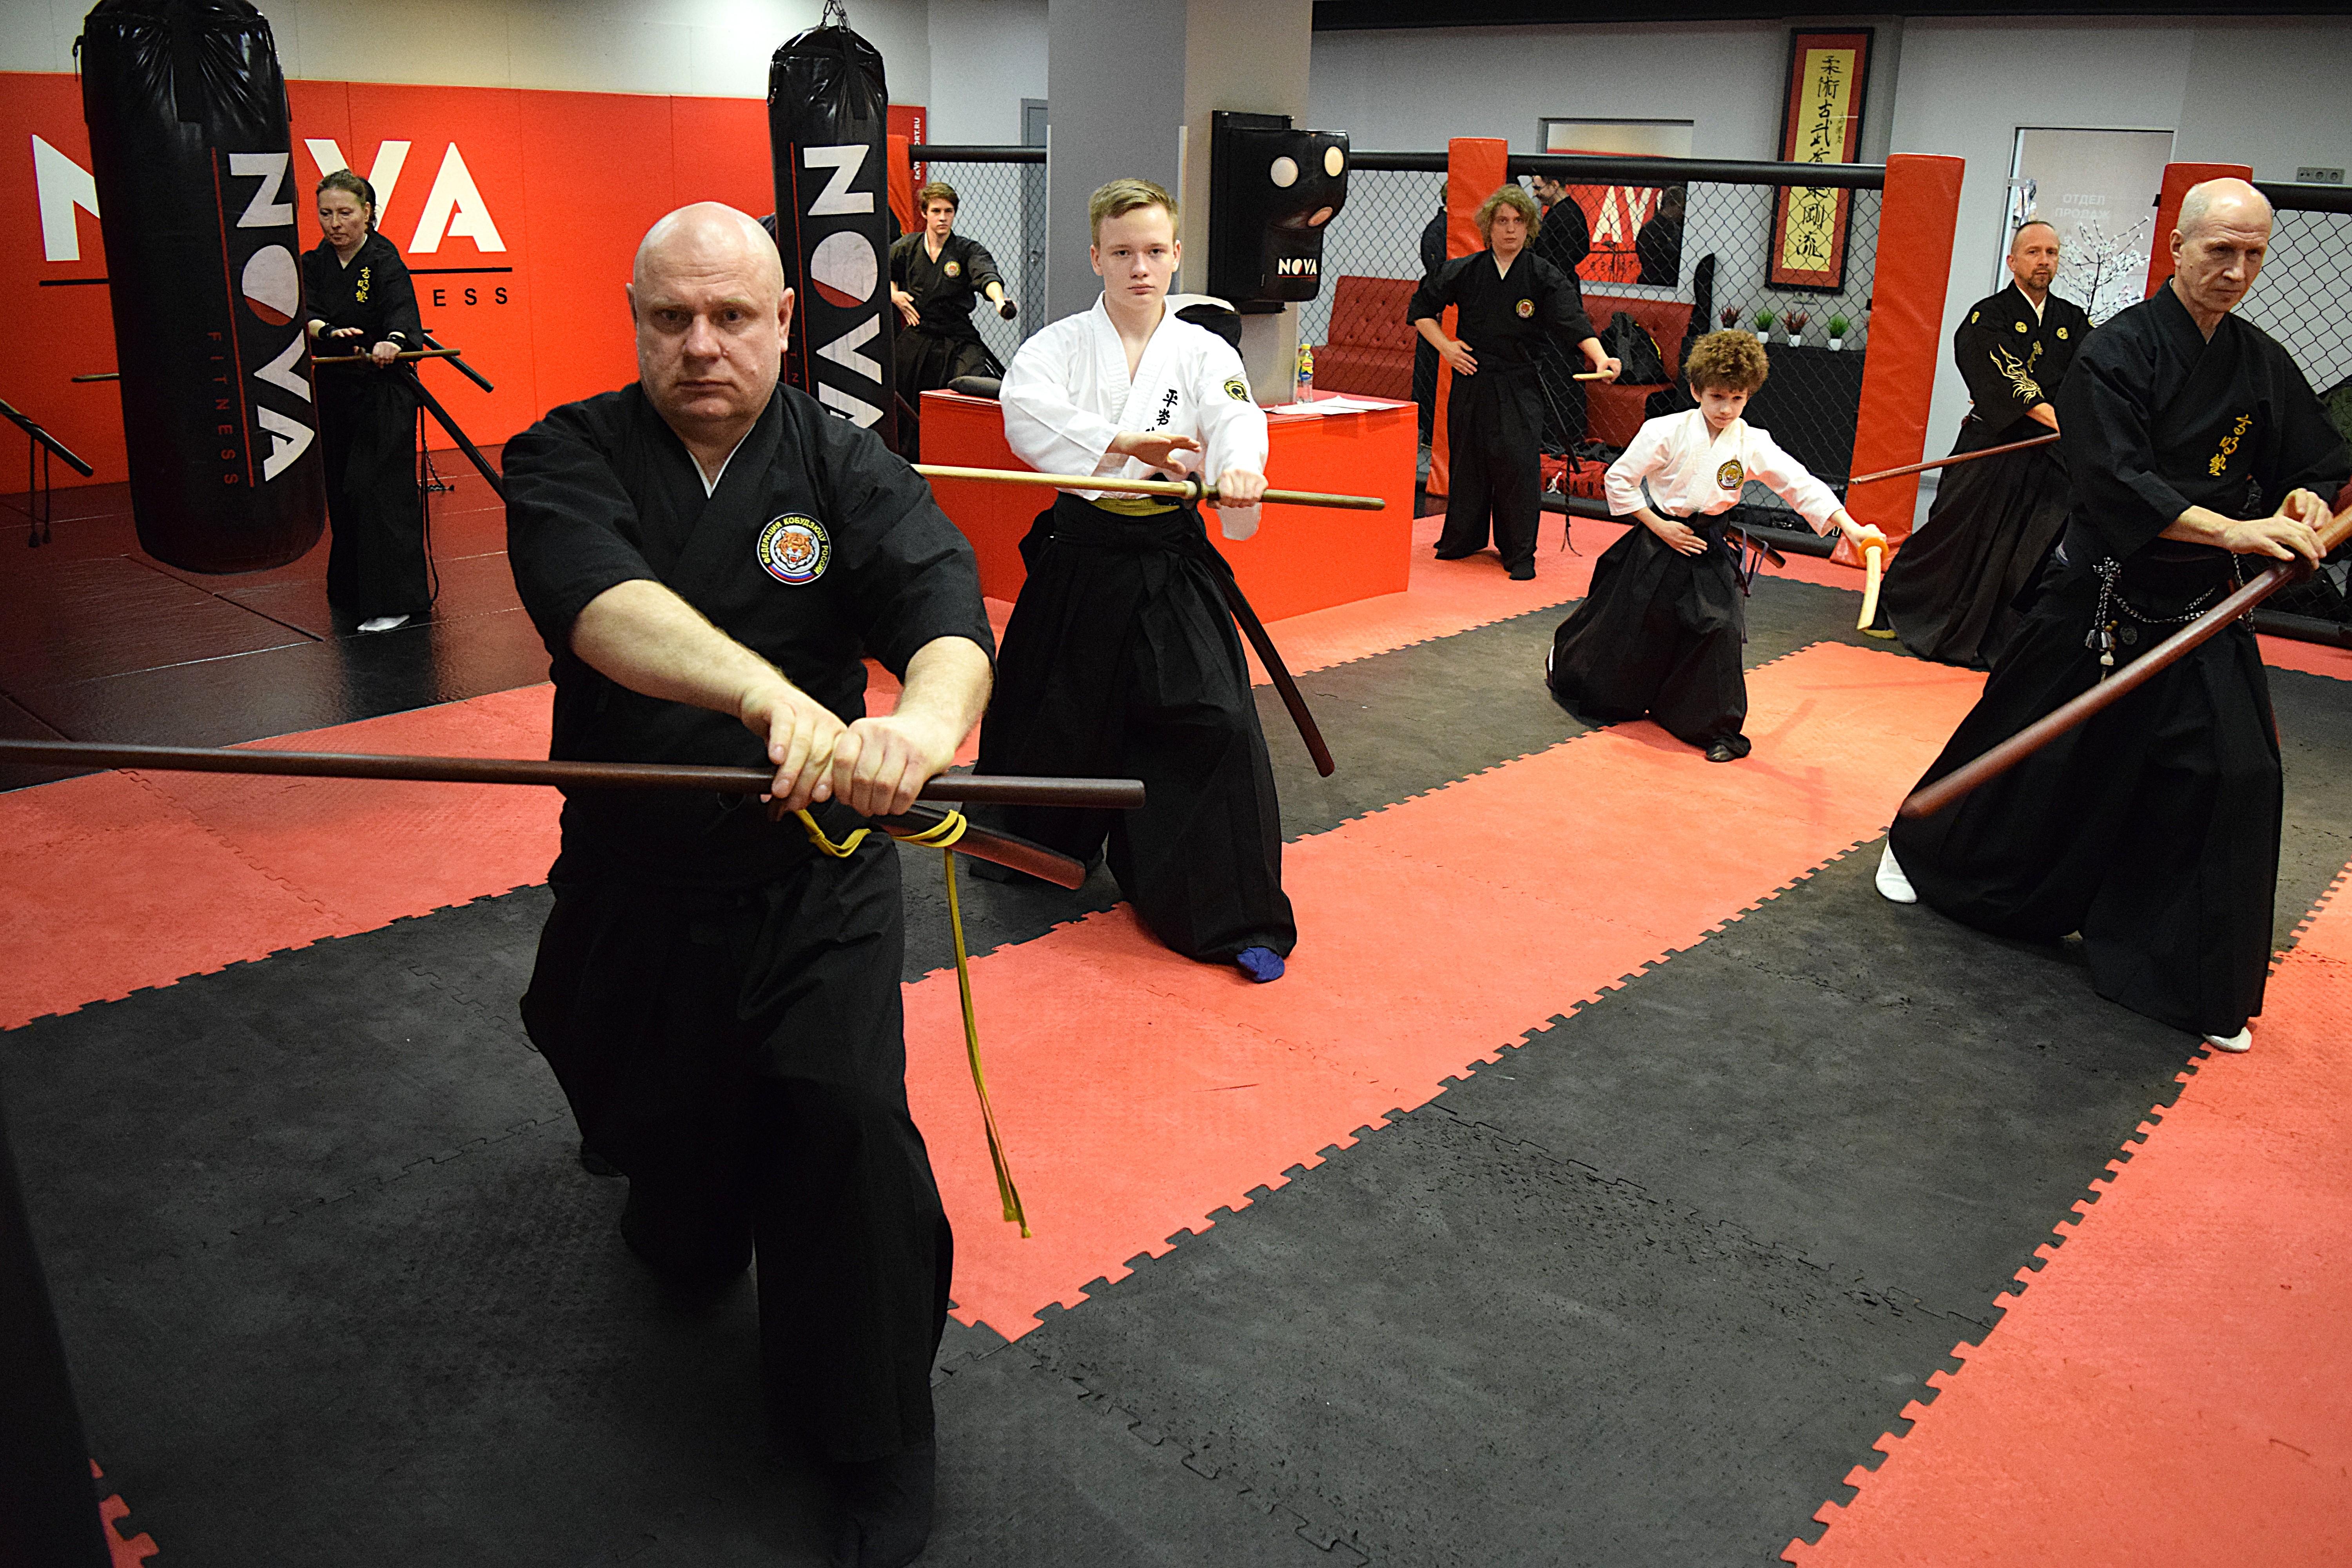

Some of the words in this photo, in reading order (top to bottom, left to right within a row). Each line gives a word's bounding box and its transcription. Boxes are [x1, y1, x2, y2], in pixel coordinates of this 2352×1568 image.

[32, 134, 507, 261] NVA
[2055, 207, 2111, 218] ПРОДАЖ
[2063, 194, 2105, 205] ОТДЕЛ
[1278, 258, 1317, 275] NOVA
[228, 152, 315, 482] NOVA
[207, 332, 238, 484] FITNESS
[761, 521, 782, 564] ФЕДЕРАЦИЯ
[783, 517, 827, 542] КОБУДЗЮЦУ
[813, 545, 829, 575] РОССИИ
